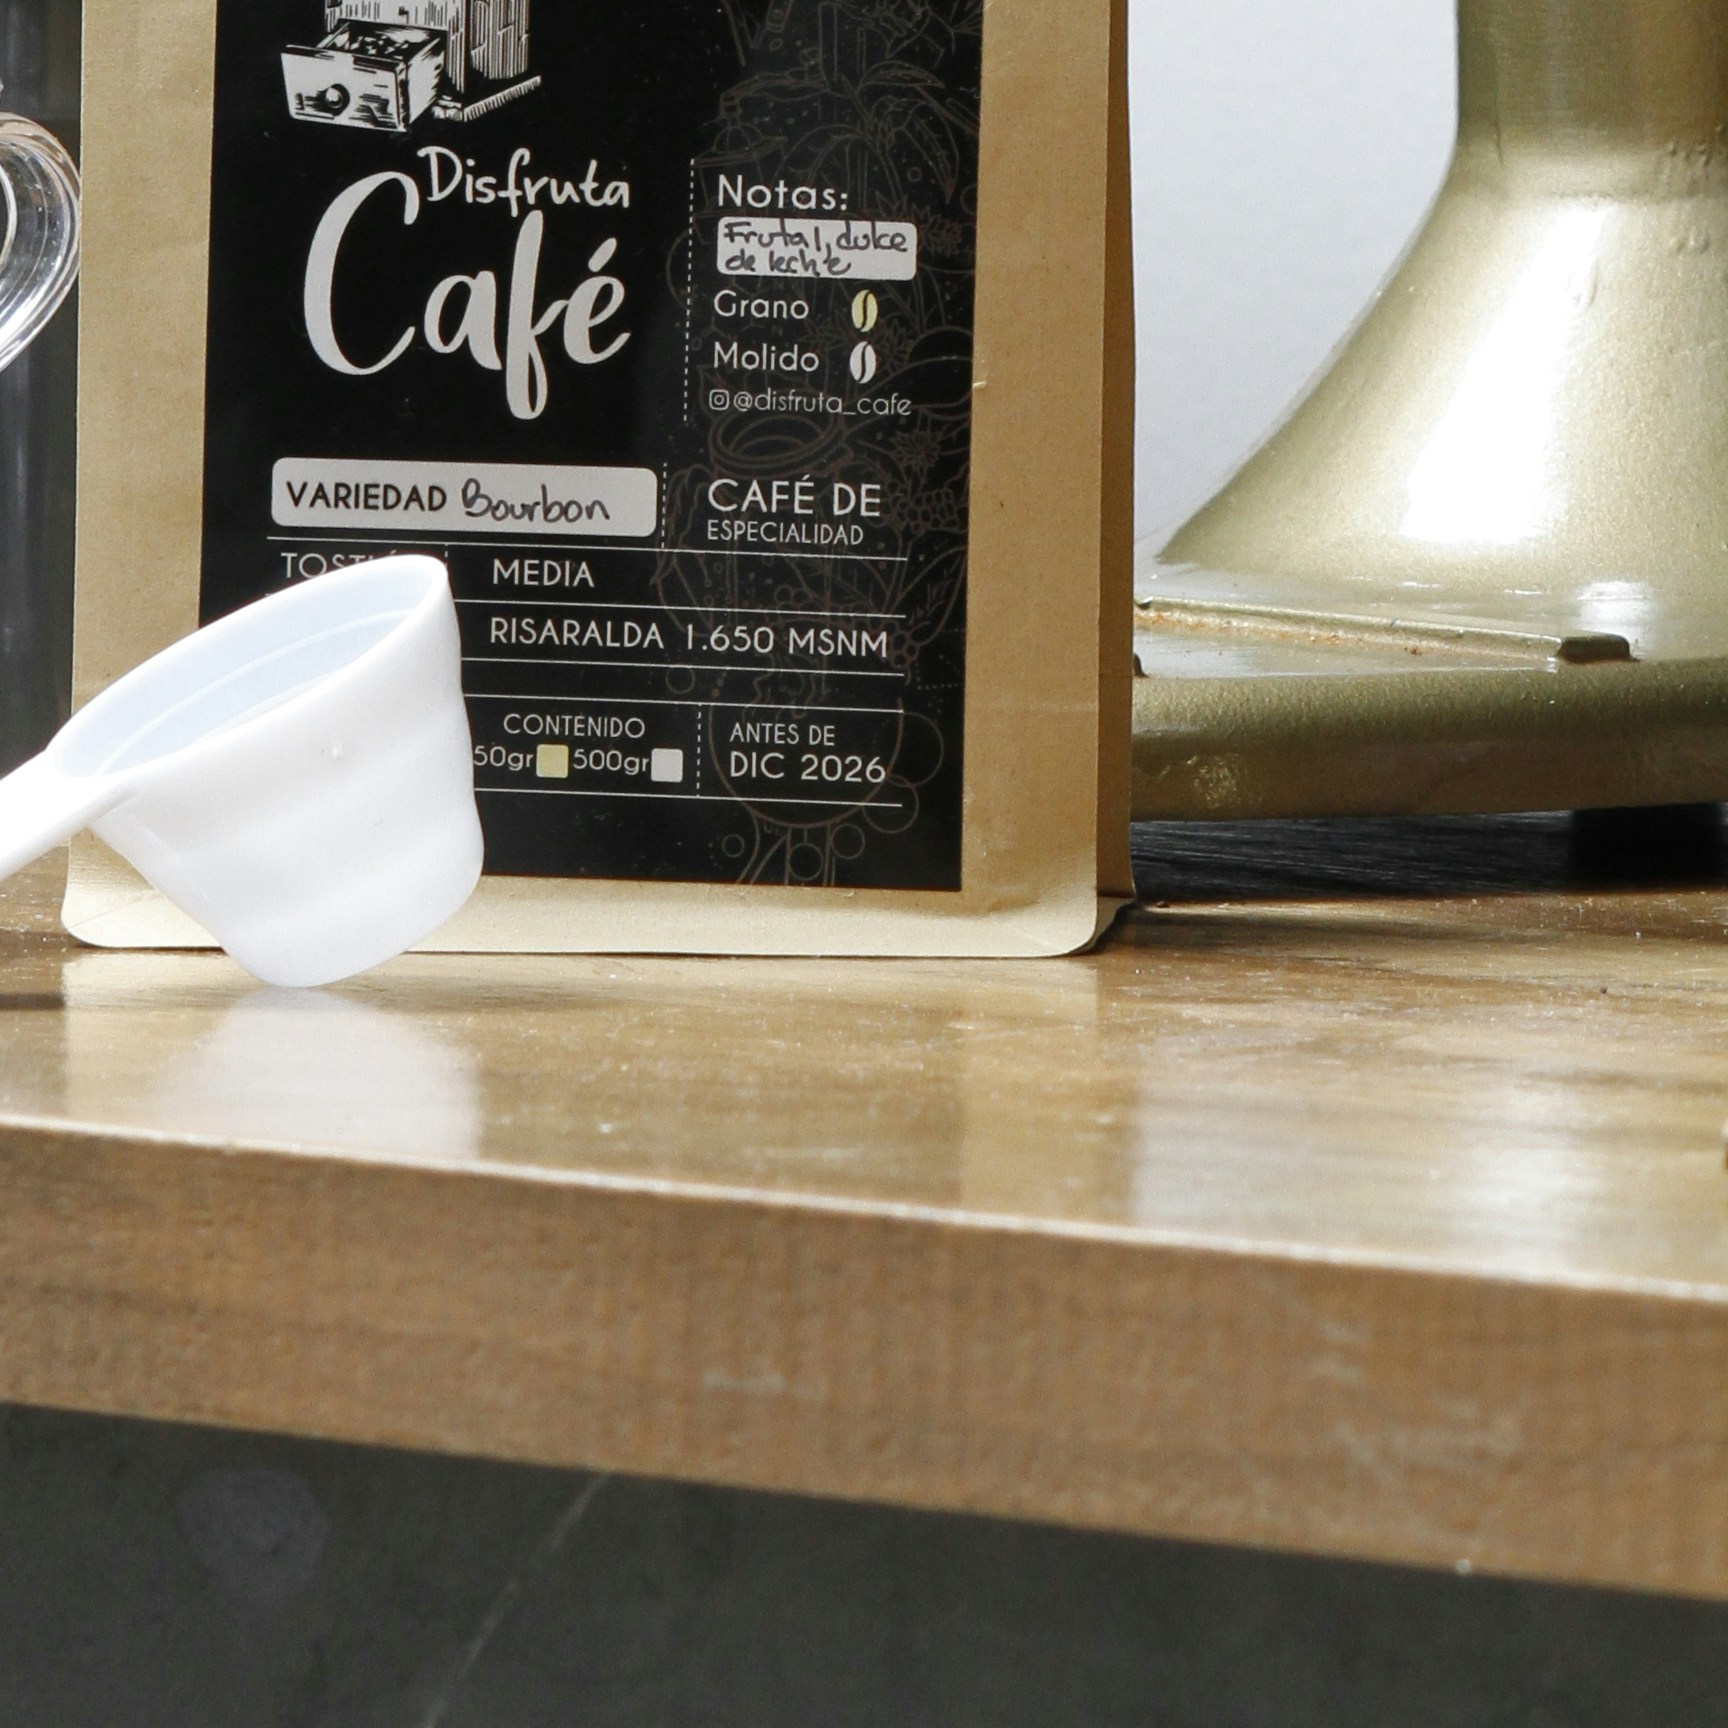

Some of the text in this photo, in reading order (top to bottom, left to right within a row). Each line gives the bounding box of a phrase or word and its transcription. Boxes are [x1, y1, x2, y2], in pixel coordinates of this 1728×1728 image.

[417, 145, 630, 218] Disfruta
[718, 174, 848, 211] Notas:
[725, 248, 756, 272] de
[304, 171, 631, 420] Café
[714, 289, 809, 319] Grano
[714, 341, 819, 372] Molido
[733, 387, 911, 415] @disfruta_cafe
[287, 478, 611, 523] VARIEDAD Bourbon
[708, 475, 881, 517] CAFÉ DE
[707, 520, 864, 545] ESPECIALIDAD
[493, 559, 595, 588] MEDIA
[490, 617, 887, 658] RISARALDA 1.650 MSNM
[503, 714, 646, 739] CONTENIDO
[729, 723, 835, 747] ANTES DE
[572, 748, 650, 775] 500gr
[730, 751, 887, 783] DIC 2026
